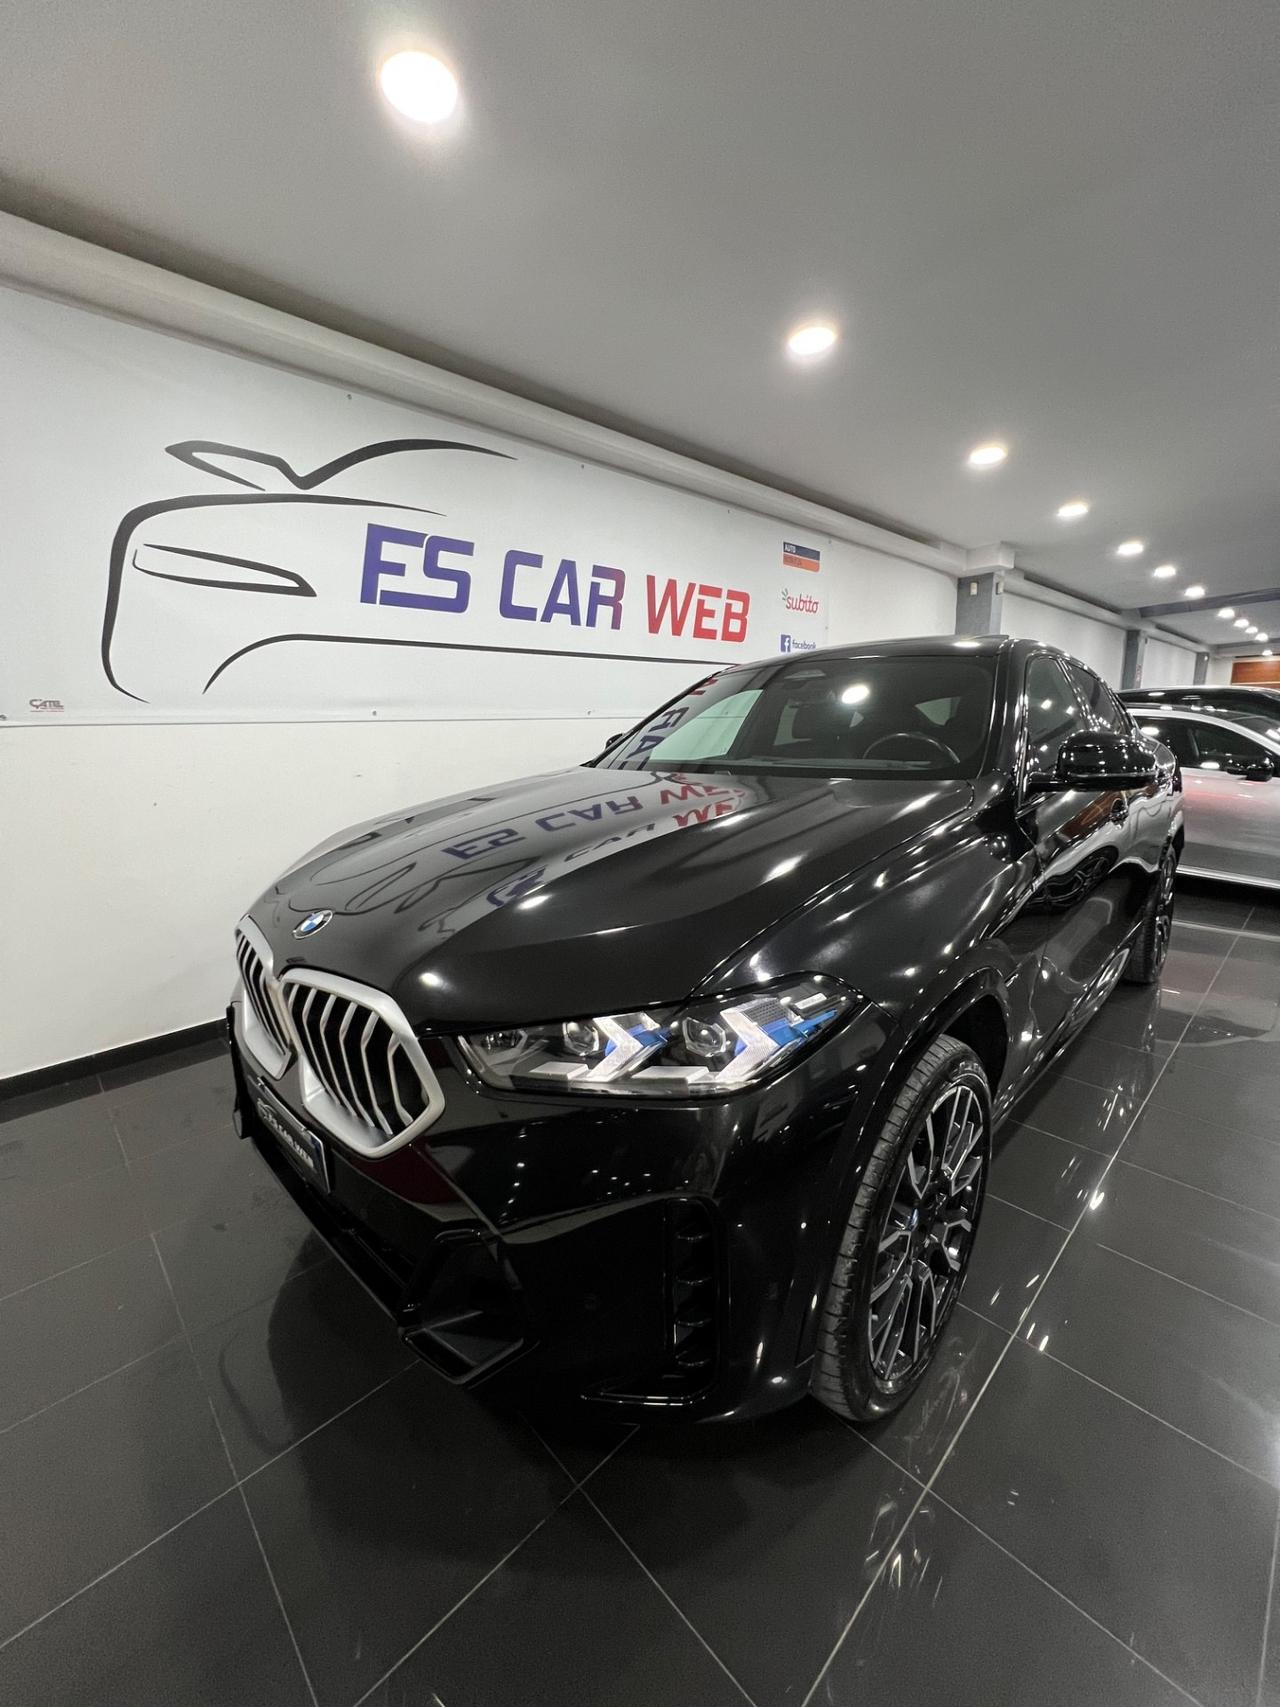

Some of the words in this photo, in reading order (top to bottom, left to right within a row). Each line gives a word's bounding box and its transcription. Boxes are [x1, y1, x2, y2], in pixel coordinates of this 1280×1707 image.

[360, 523, 475, 613] ES
[499, 549, 626, 630] CAR
[646, 574, 751, 643] WEB
[785, 593, 819, 614] subito
[792, 639, 817, 651] facebook
